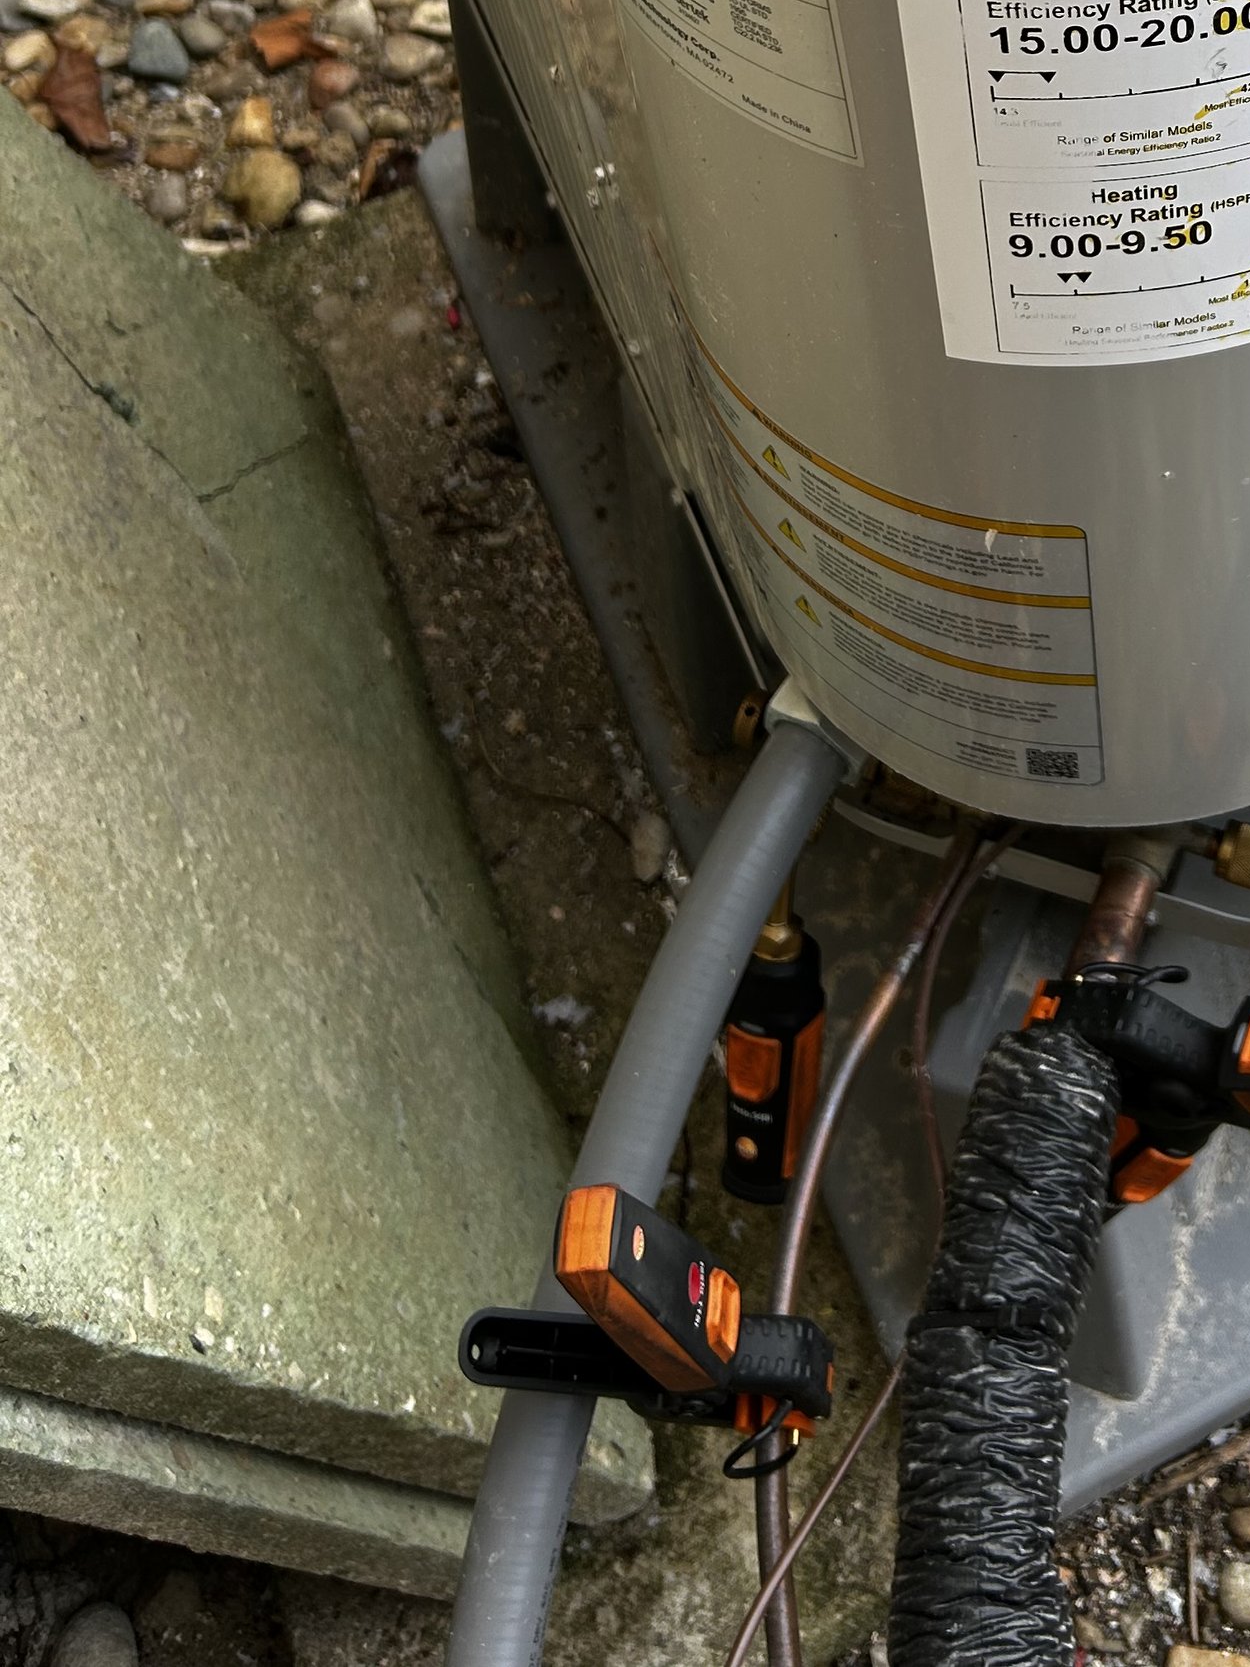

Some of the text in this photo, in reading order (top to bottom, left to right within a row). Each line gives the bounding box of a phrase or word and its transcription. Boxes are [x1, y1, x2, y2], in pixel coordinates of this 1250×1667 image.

[987, 0, 1111, 22] Efficiency
[686, 45, 702, 63] MA
[690, 36, 721, 62] Corp.
[741, 94, 812, 134] Made in China
[1103, 120, 1213, 143] of Similar Models
[1107, 145, 1141, 157] Energy
[1143, 139, 1189, 153] Efficiency
[1092, 182, 1179, 205] Heating
[1009, 201, 1203, 229] Efficiency Rating
[1008, 220, 1213, 259] 9.00-9.50
[1174, 311, 1217, 327] Models
